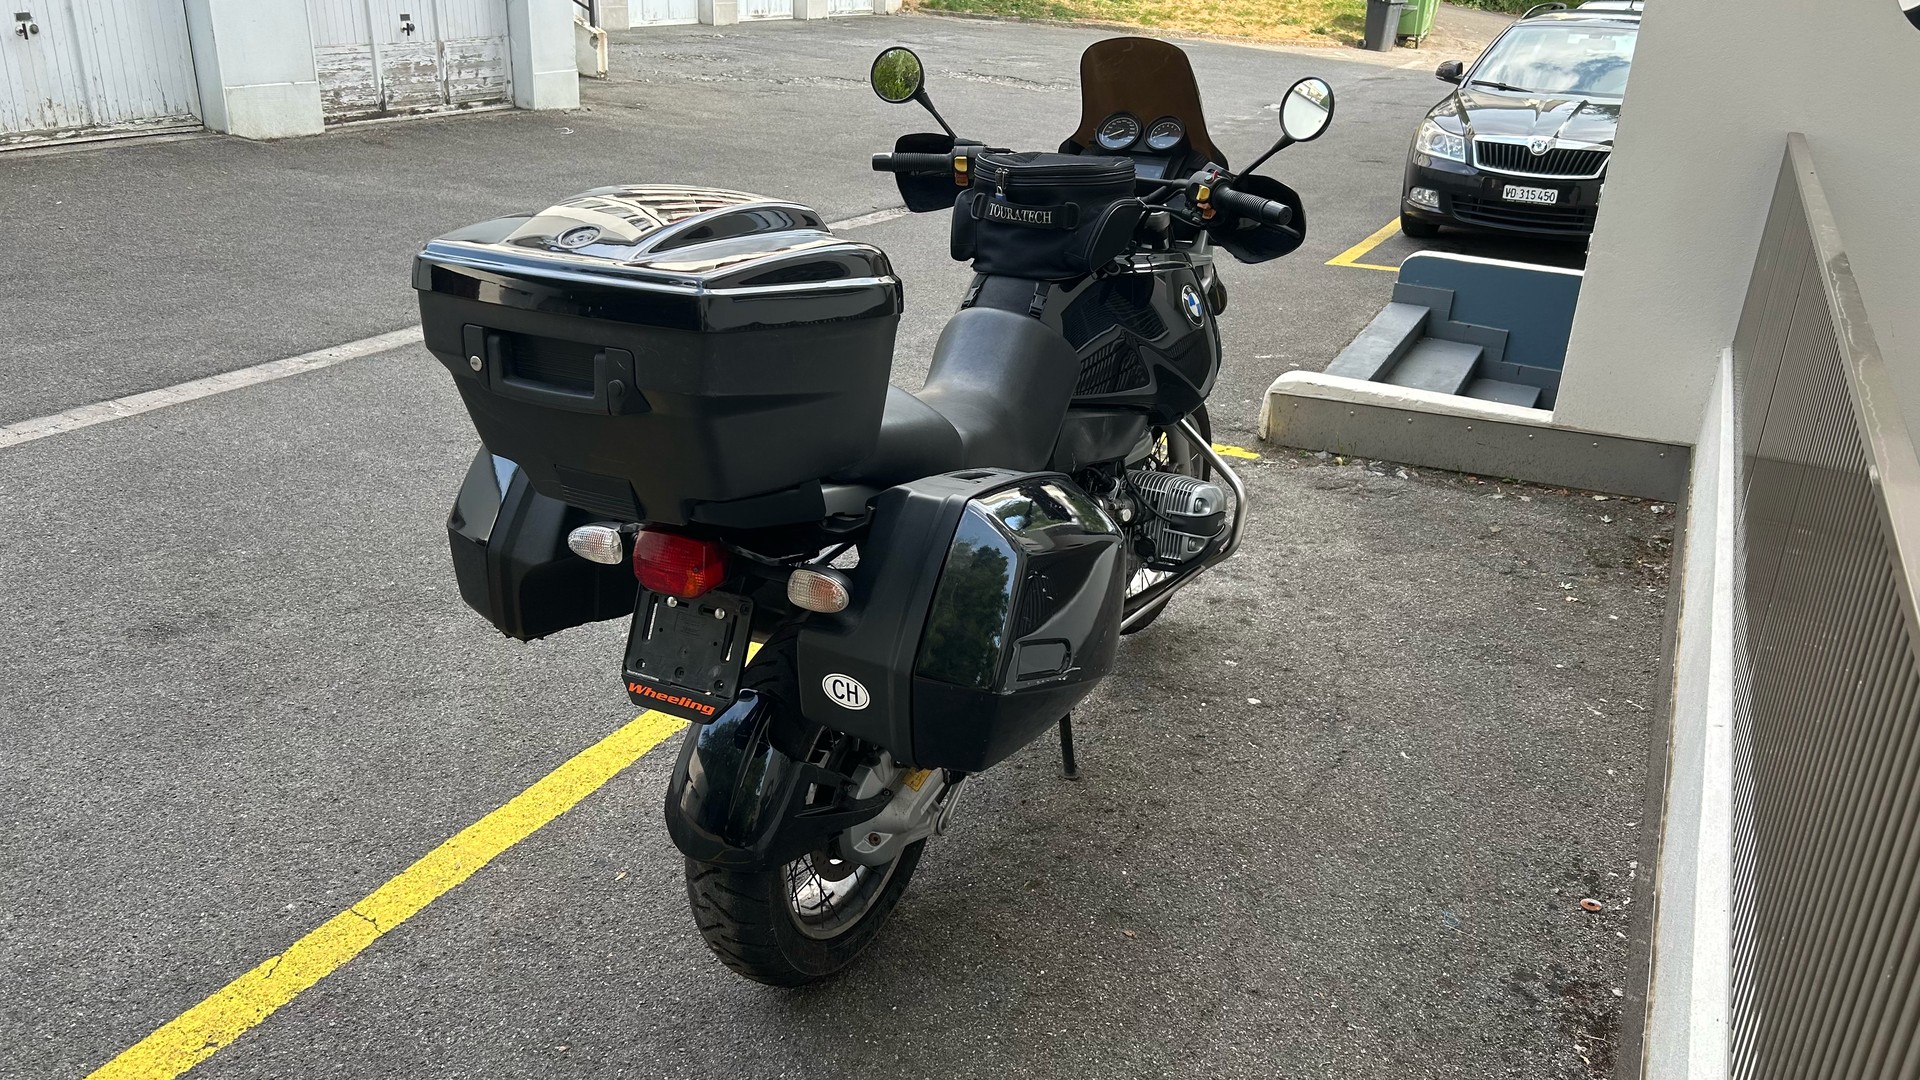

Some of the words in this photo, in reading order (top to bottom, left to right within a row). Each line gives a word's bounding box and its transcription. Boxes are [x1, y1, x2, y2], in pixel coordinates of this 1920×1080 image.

[989, 202, 1052, 224] TOURATECH
[628, 682, 716, 716] Wheeling
[832, 679, 859, 705] CH
